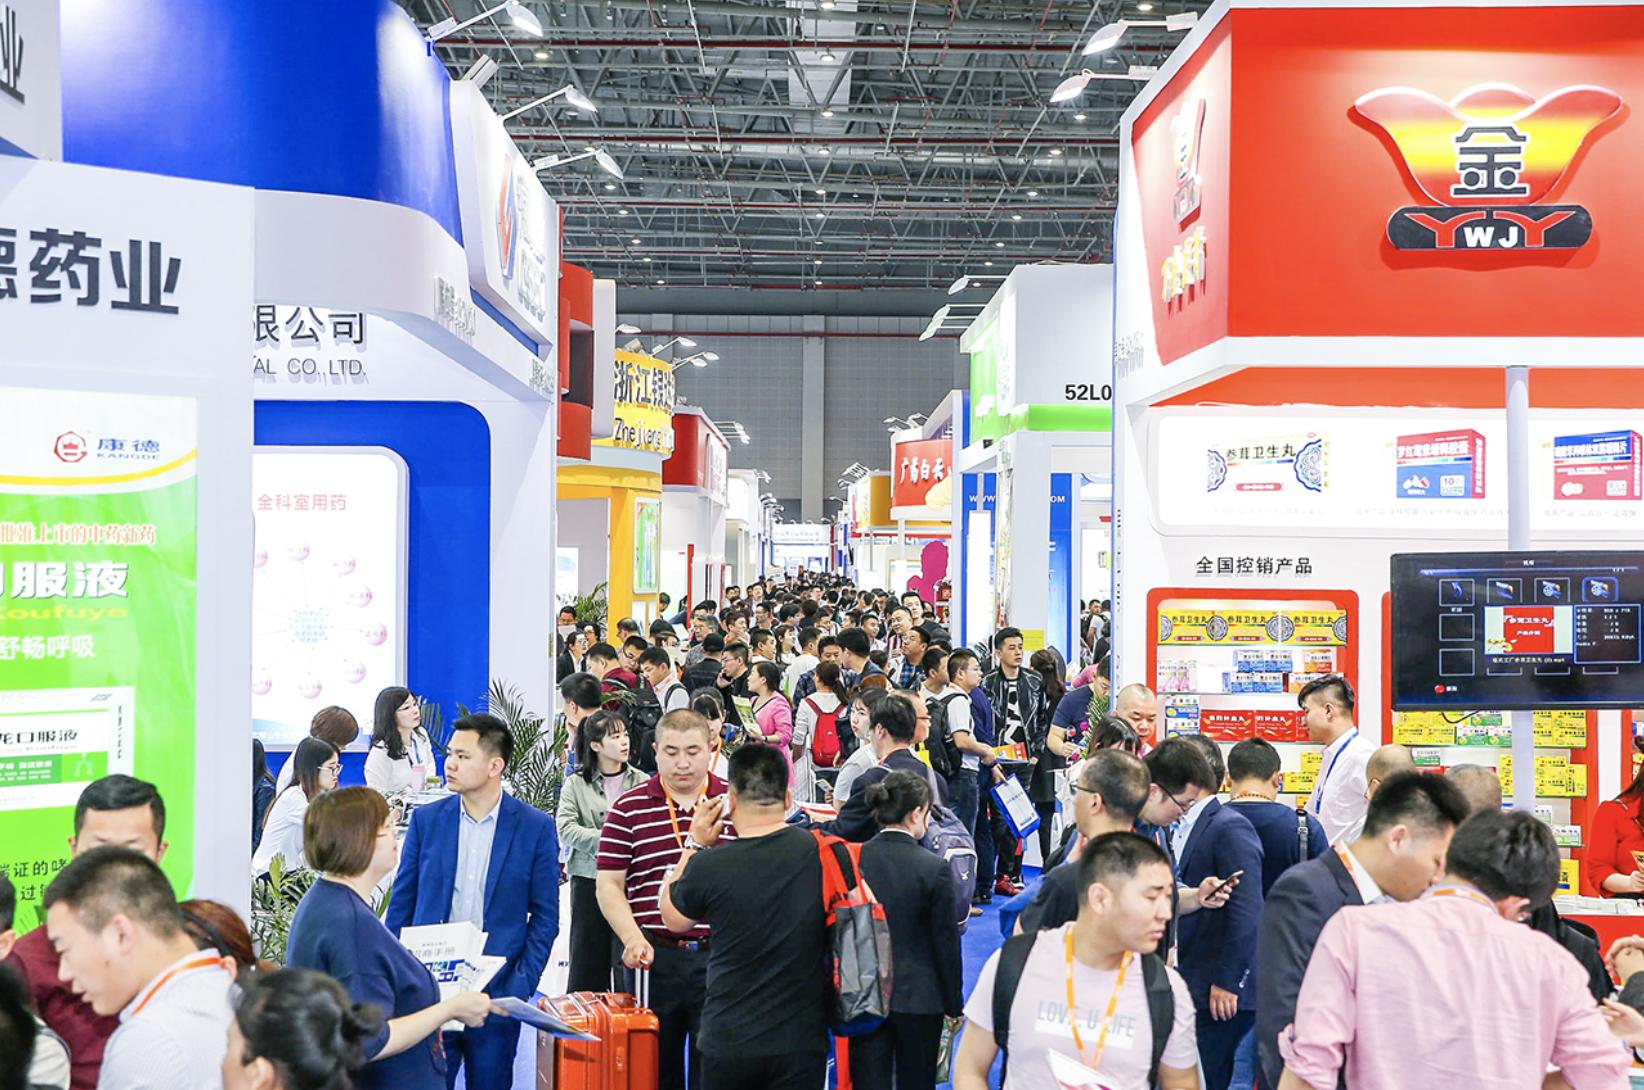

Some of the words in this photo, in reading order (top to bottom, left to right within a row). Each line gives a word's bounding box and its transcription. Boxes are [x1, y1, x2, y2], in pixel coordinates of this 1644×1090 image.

[98, 438, 160, 453] 康德
[257, 493, 347, 511] 全科室用药
[1196, 555, 1313, 575] 全国控销产品
[0, 561, 128, 599] 服液
